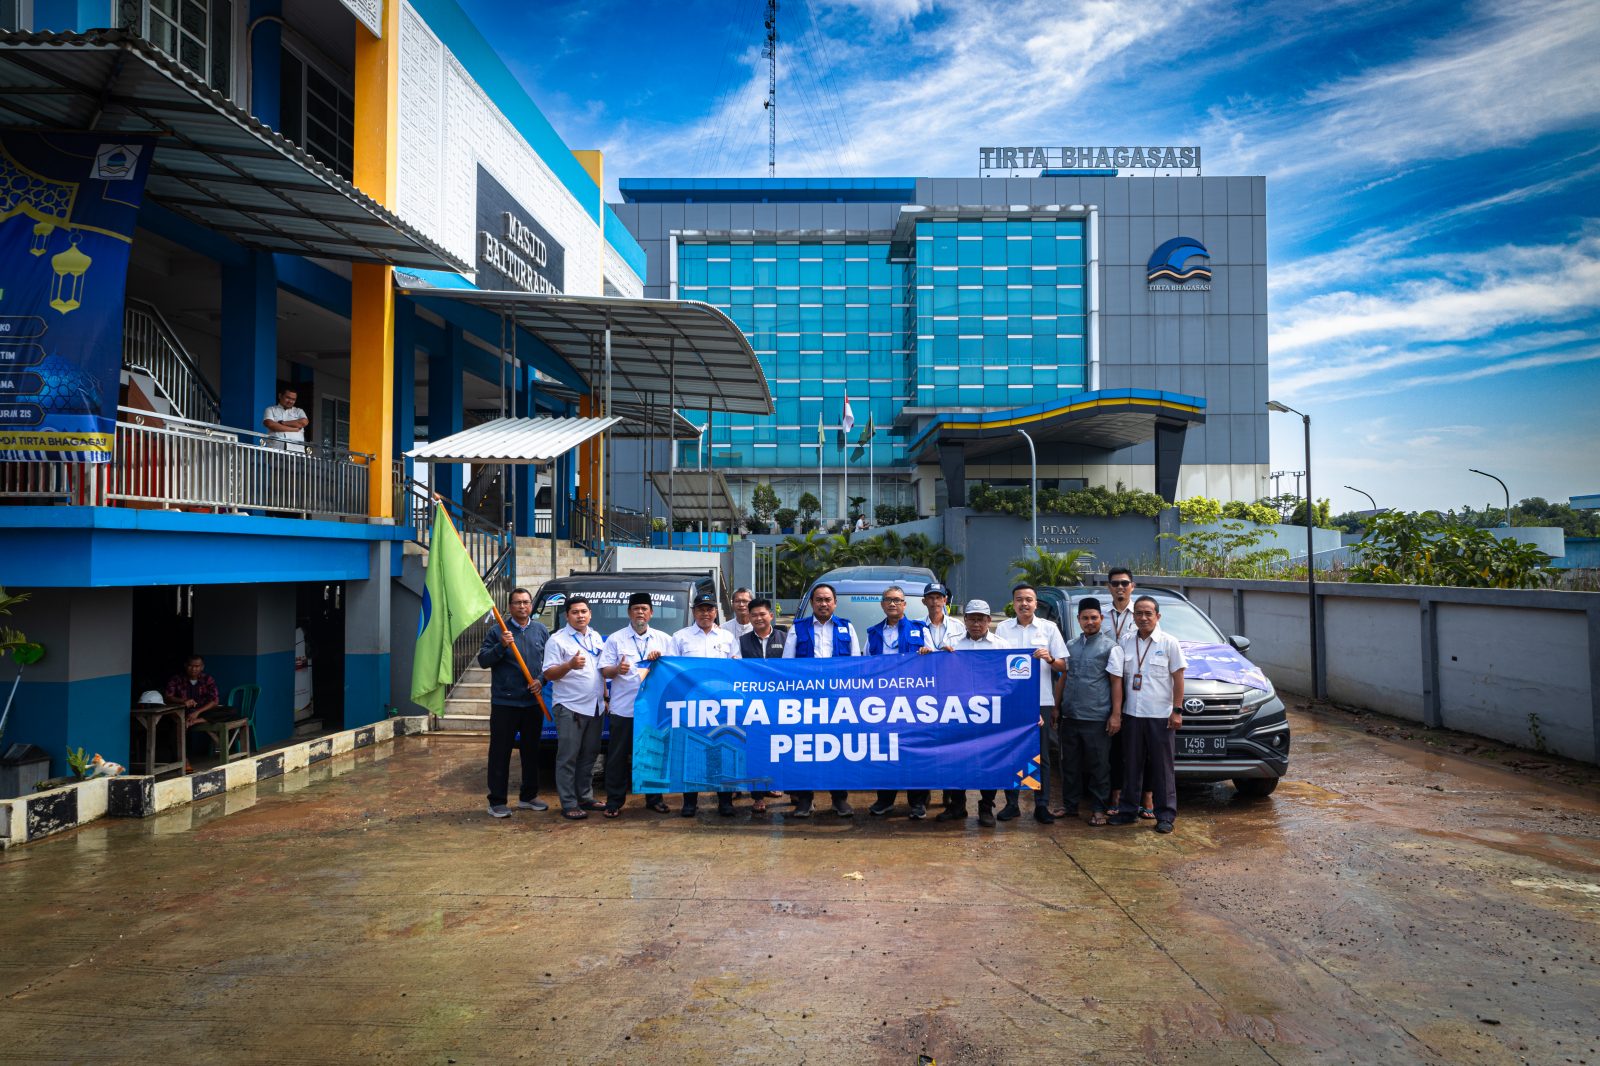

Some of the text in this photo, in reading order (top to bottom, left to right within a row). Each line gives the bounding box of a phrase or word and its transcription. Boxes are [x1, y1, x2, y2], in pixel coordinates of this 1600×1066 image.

[980, 146, 1200, 168] TIRTA BHAGASASI
[502, 211, 547, 268] MASJID
[19, 409, 32, 418] ZIS
[0, 436, 16, 445] DA
[19, 436, 46, 446] TIRTA
[1042, 525, 1080, 535] PDAM
[733, 676, 935, 692] PERUSAHAAN UMUM DAERAH
[666, 696, 1001, 728] TIRTA BHAGASASI
[770, 732, 899, 762] PEDULI
[1184, 737, 1225, 749] 1456 GU
